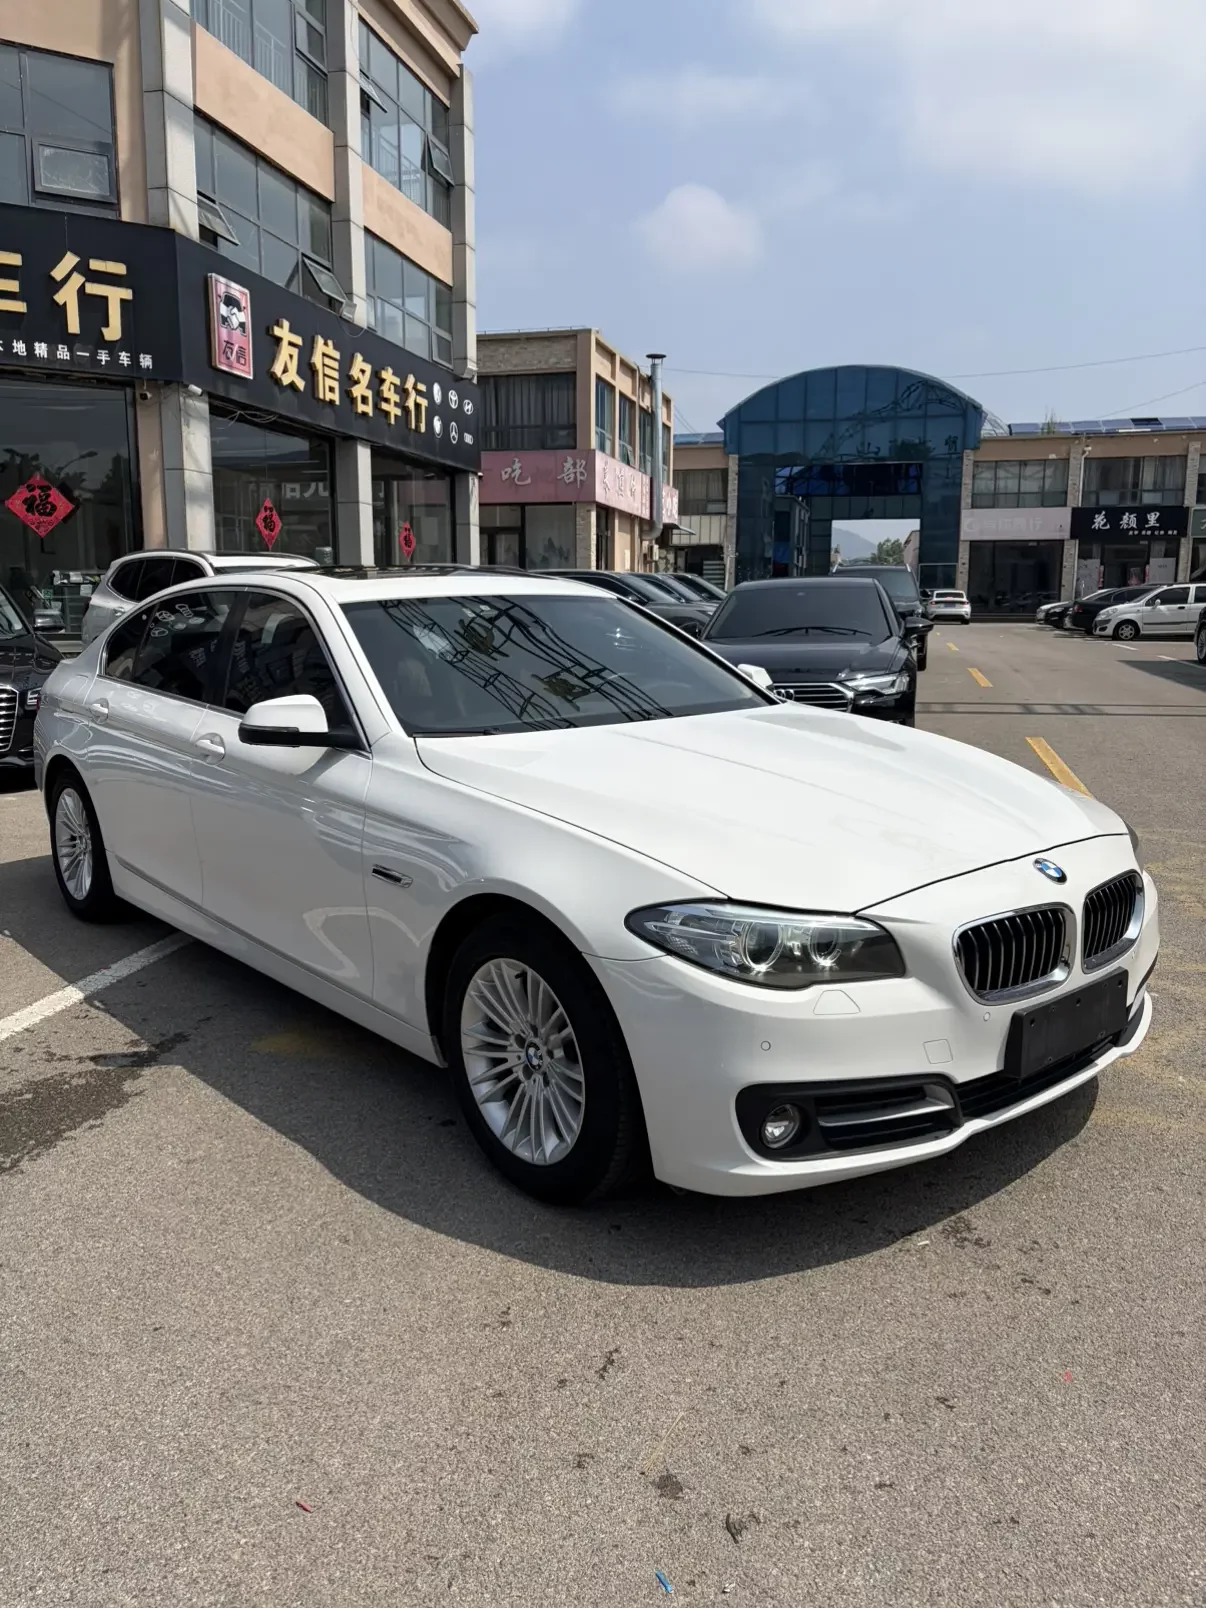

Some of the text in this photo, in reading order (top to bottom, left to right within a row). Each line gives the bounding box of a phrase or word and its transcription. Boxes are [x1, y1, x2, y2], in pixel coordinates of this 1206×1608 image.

[222, 339, 247, 366] 友信
[269, 317, 429, 434] 友信名车行
[22, 483, 57, 517] 福
